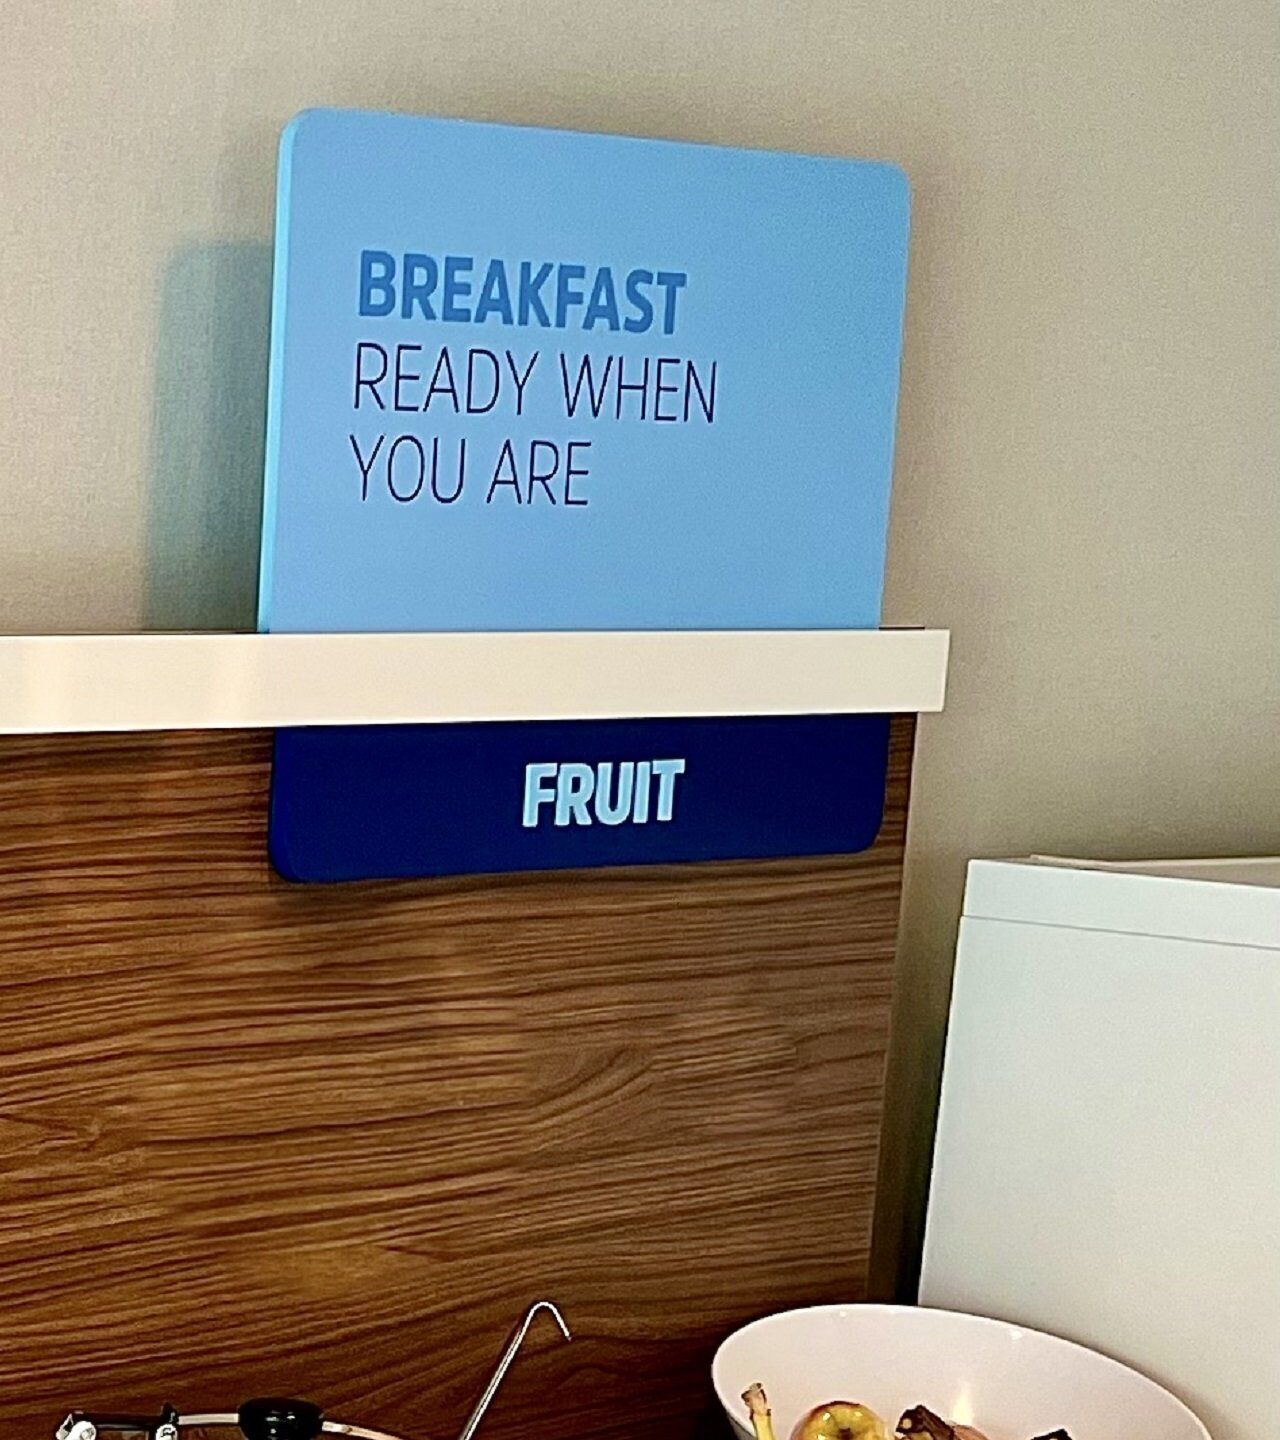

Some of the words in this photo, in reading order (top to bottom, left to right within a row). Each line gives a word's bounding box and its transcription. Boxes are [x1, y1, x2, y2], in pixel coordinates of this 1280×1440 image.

[358, 249, 688, 336] BREAKFAST
[353, 341, 540, 417] READY
[559, 349, 718, 424] WHEN
[349, 432, 467, 504] YOU
[485, 437, 593, 506] ARE
[521, 757, 687, 829] FRUIT
